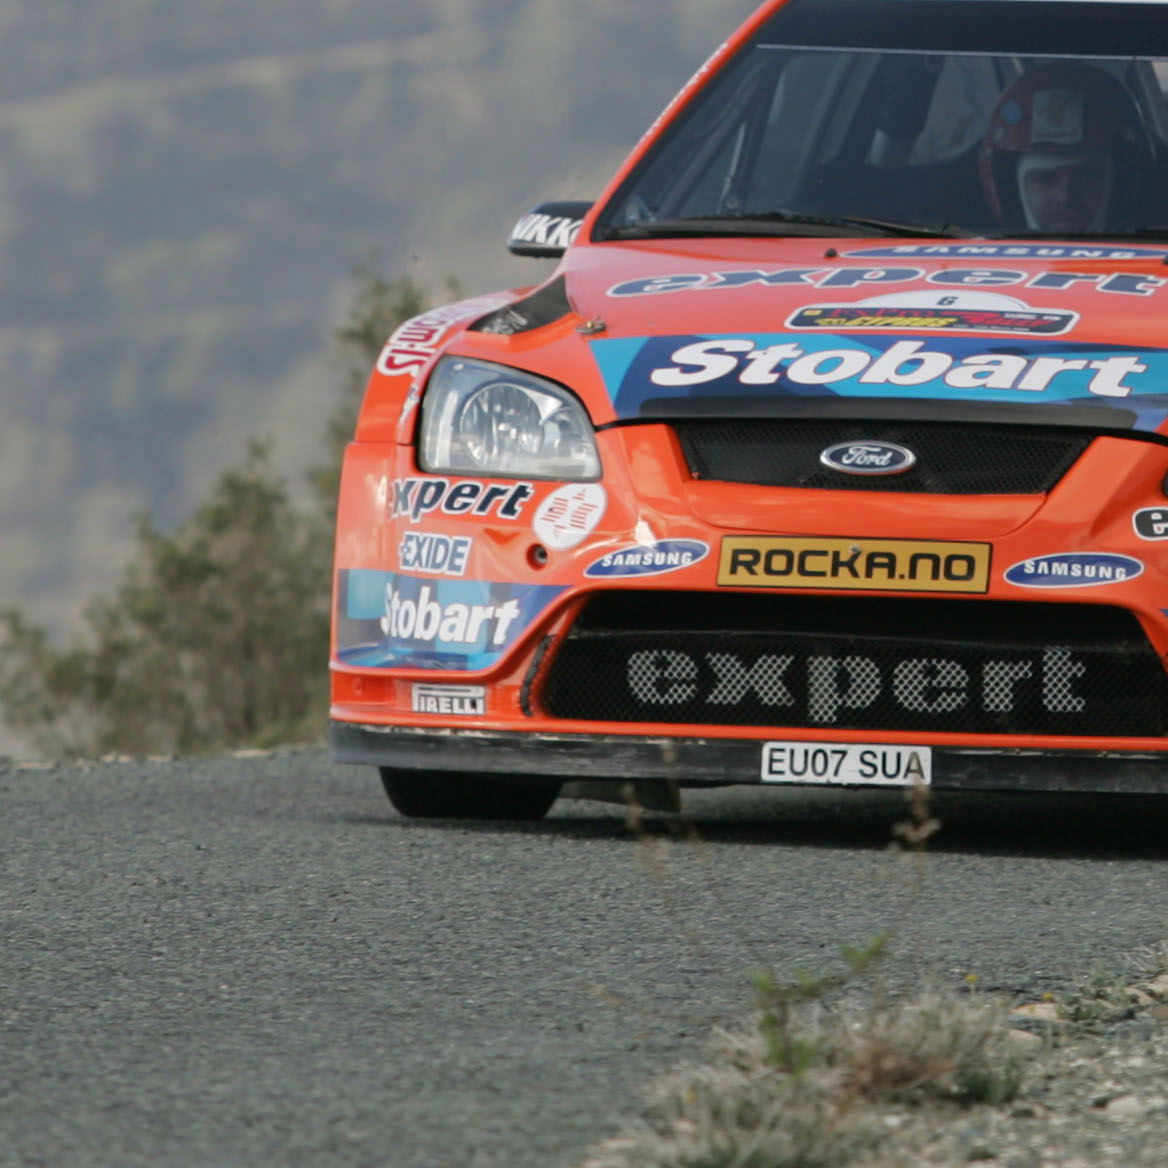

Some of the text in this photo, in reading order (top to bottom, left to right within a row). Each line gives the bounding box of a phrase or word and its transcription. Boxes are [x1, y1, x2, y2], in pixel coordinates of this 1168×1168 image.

[511, 214, 585, 248] NIKK
[894, 245, 1134, 258] SAMSUNG
[606, 266, 1168, 298] expert
[937, 296, 958, 306] 6
[651, 339, 1148, 398] Stobart
[841, 446, 892, 466] Ford
[391, 479, 534, 524] xpert
[401, 533, 472, 574] EXIDE
[601, 551, 693, 567] SAMSUNG
[729, 548, 976, 581] ROCKA.NO
[1023, 558, 1127, 580] SAMSUNG
[412, 683, 486, 714] PIRELLI
[627, 645, 1086, 723] expert
[767, 747, 925, 779] EU07 SUA
